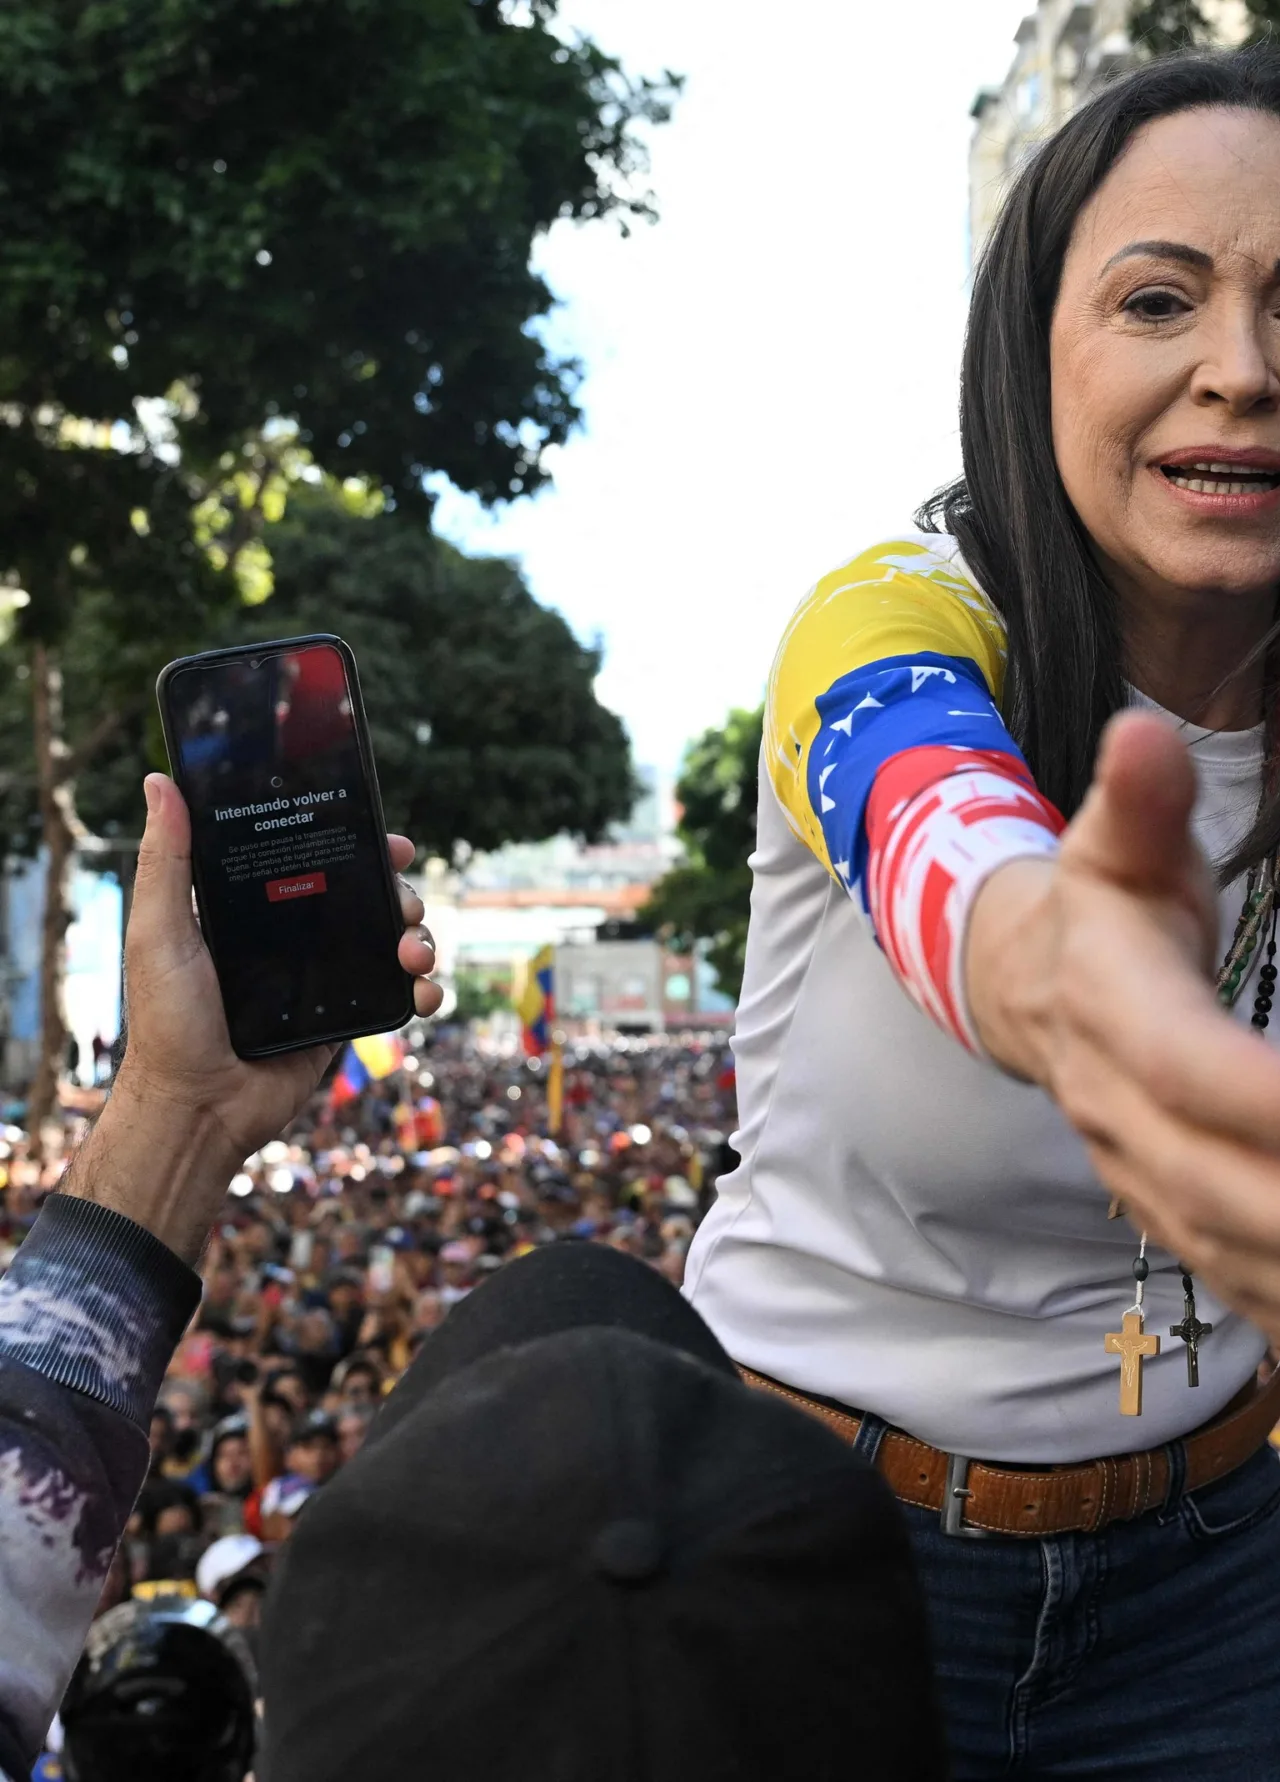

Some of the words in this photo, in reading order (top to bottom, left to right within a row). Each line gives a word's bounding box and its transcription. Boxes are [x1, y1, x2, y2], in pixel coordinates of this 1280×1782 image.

[215, 798, 289, 821] Intentando
[293, 790, 334, 806] volver
[339, 788, 347, 798] a
[255, 811, 314, 831] conectar
[240, 843, 258, 852] puso
[272, 837, 293, 846] pausa
[222, 854, 247, 865] porque
[258, 846, 290, 857] conexión
[253, 858, 281, 867] Cambia
[295, 851, 313, 861] lugar
[315, 849, 330, 858] para
[333, 844, 355, 852] recibir
[230, 874, 250, 882] mejor
[253, 868, 272, 878] señal
[281, 862, 301, 872] detén
[279, 880, 314, 894] Finalizar
